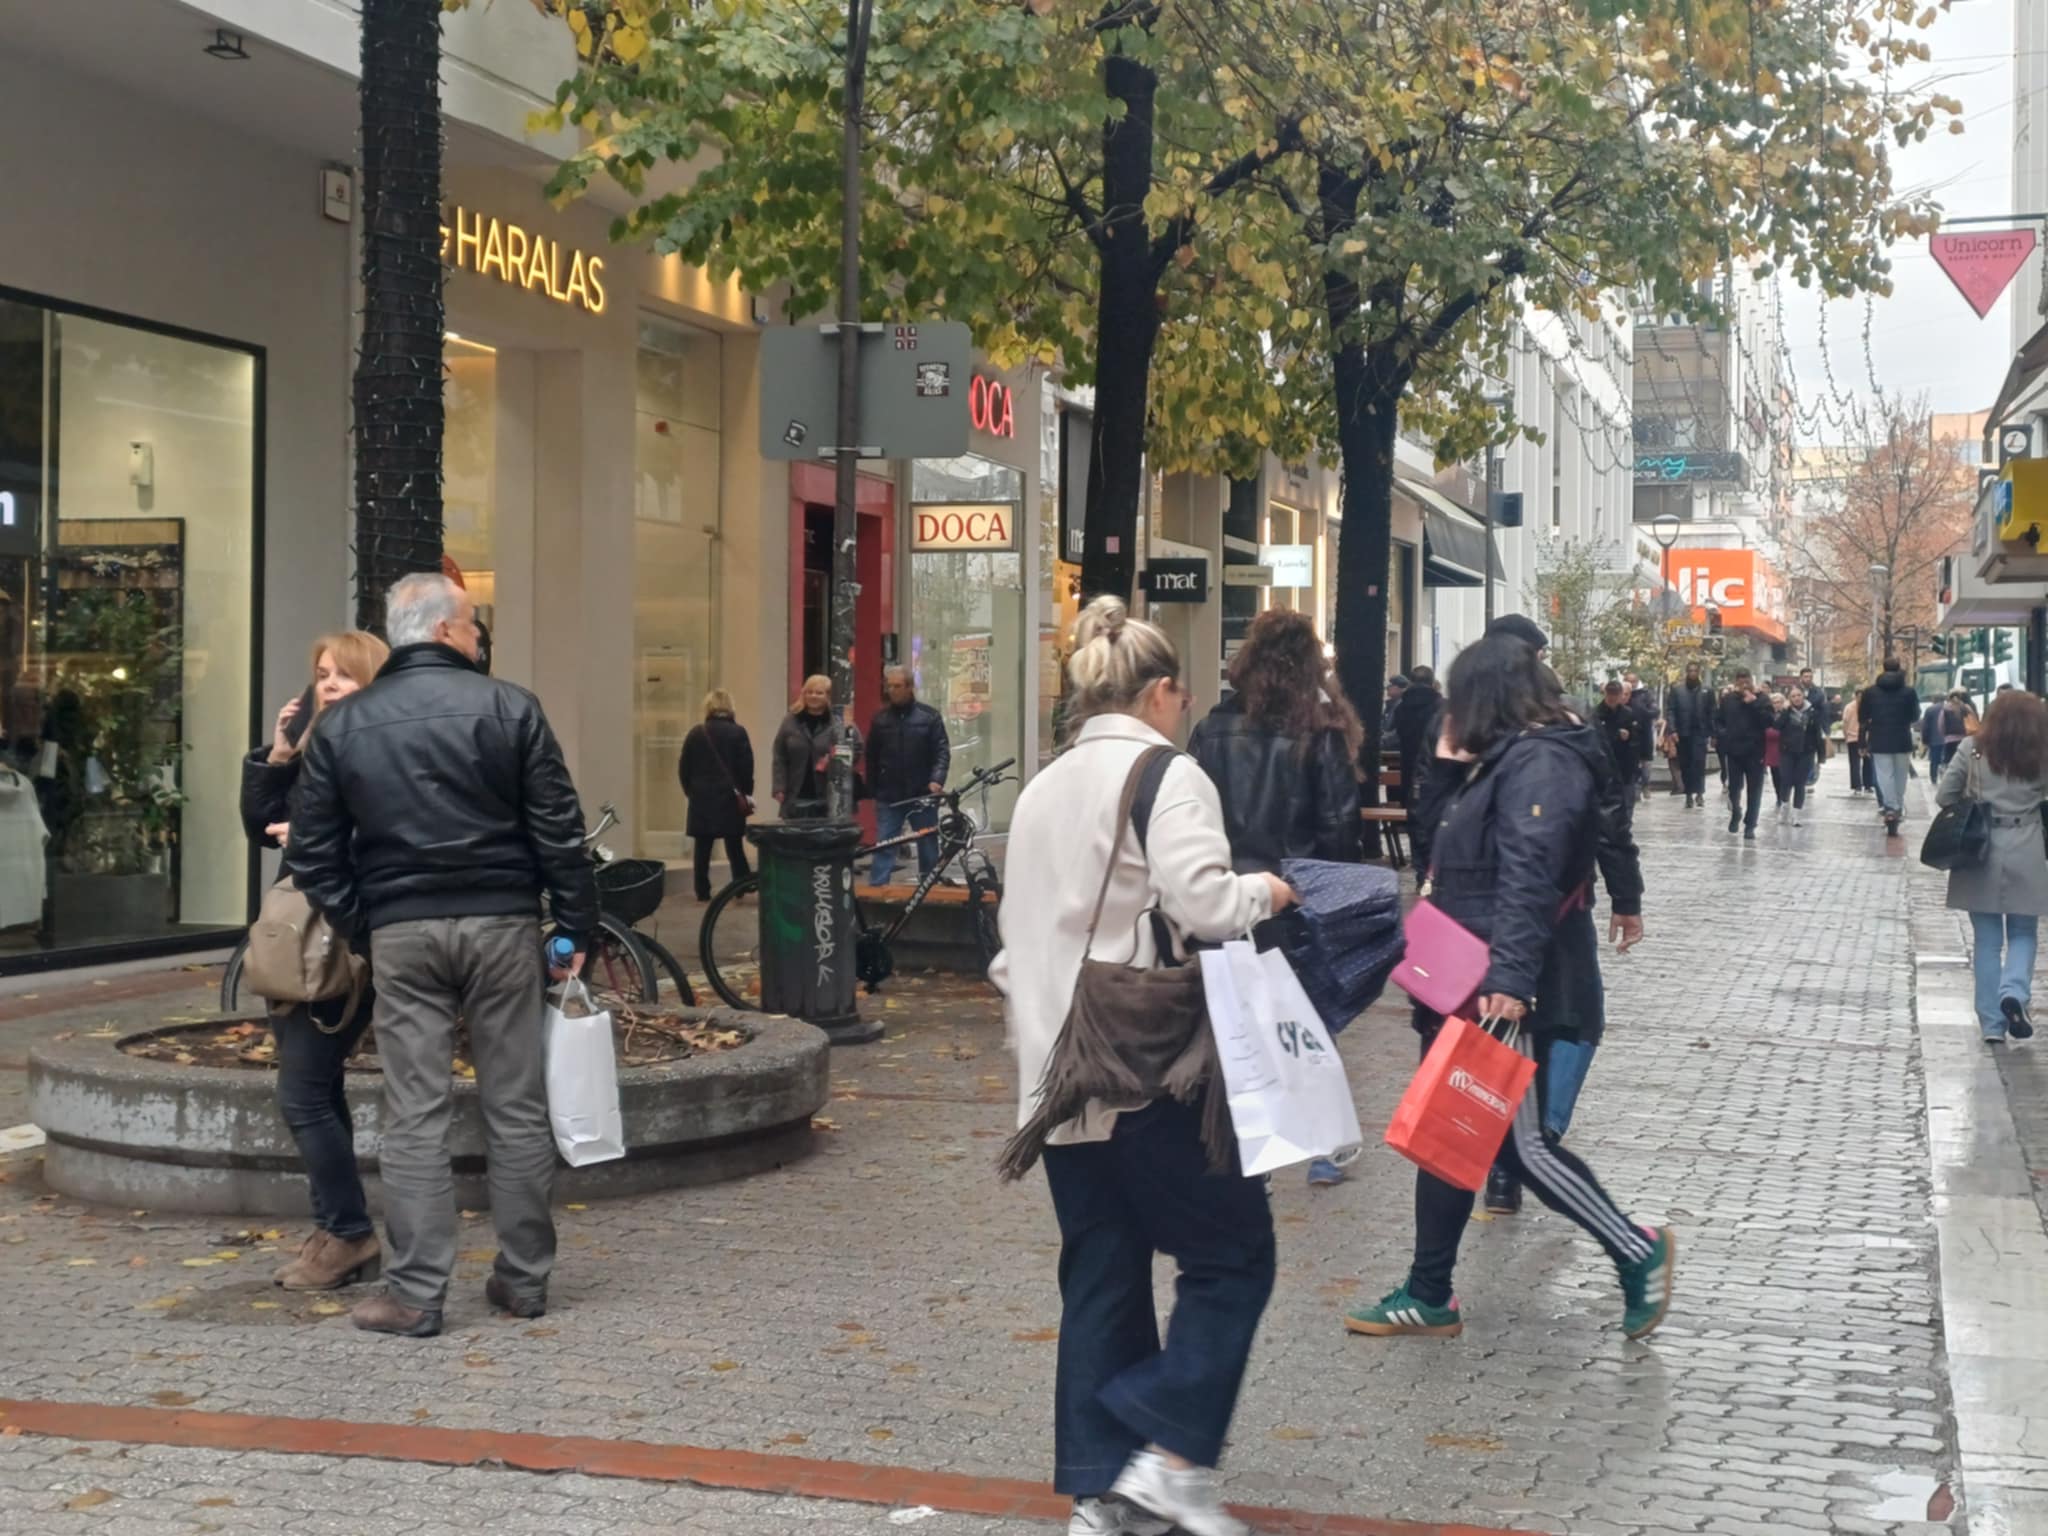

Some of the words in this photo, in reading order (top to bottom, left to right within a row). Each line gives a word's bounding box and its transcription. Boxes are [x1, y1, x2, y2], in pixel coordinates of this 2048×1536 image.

[457, 206, 605, 313] HARALAS
[1943, 237, 2023, 254] Unicorn
[968, 374, 1014, 439] OCA
[918, 512, 1008, 543] DOCA
[1155, 571, 1198, 590] mat
[1668, 567, 1745, 607] lic
